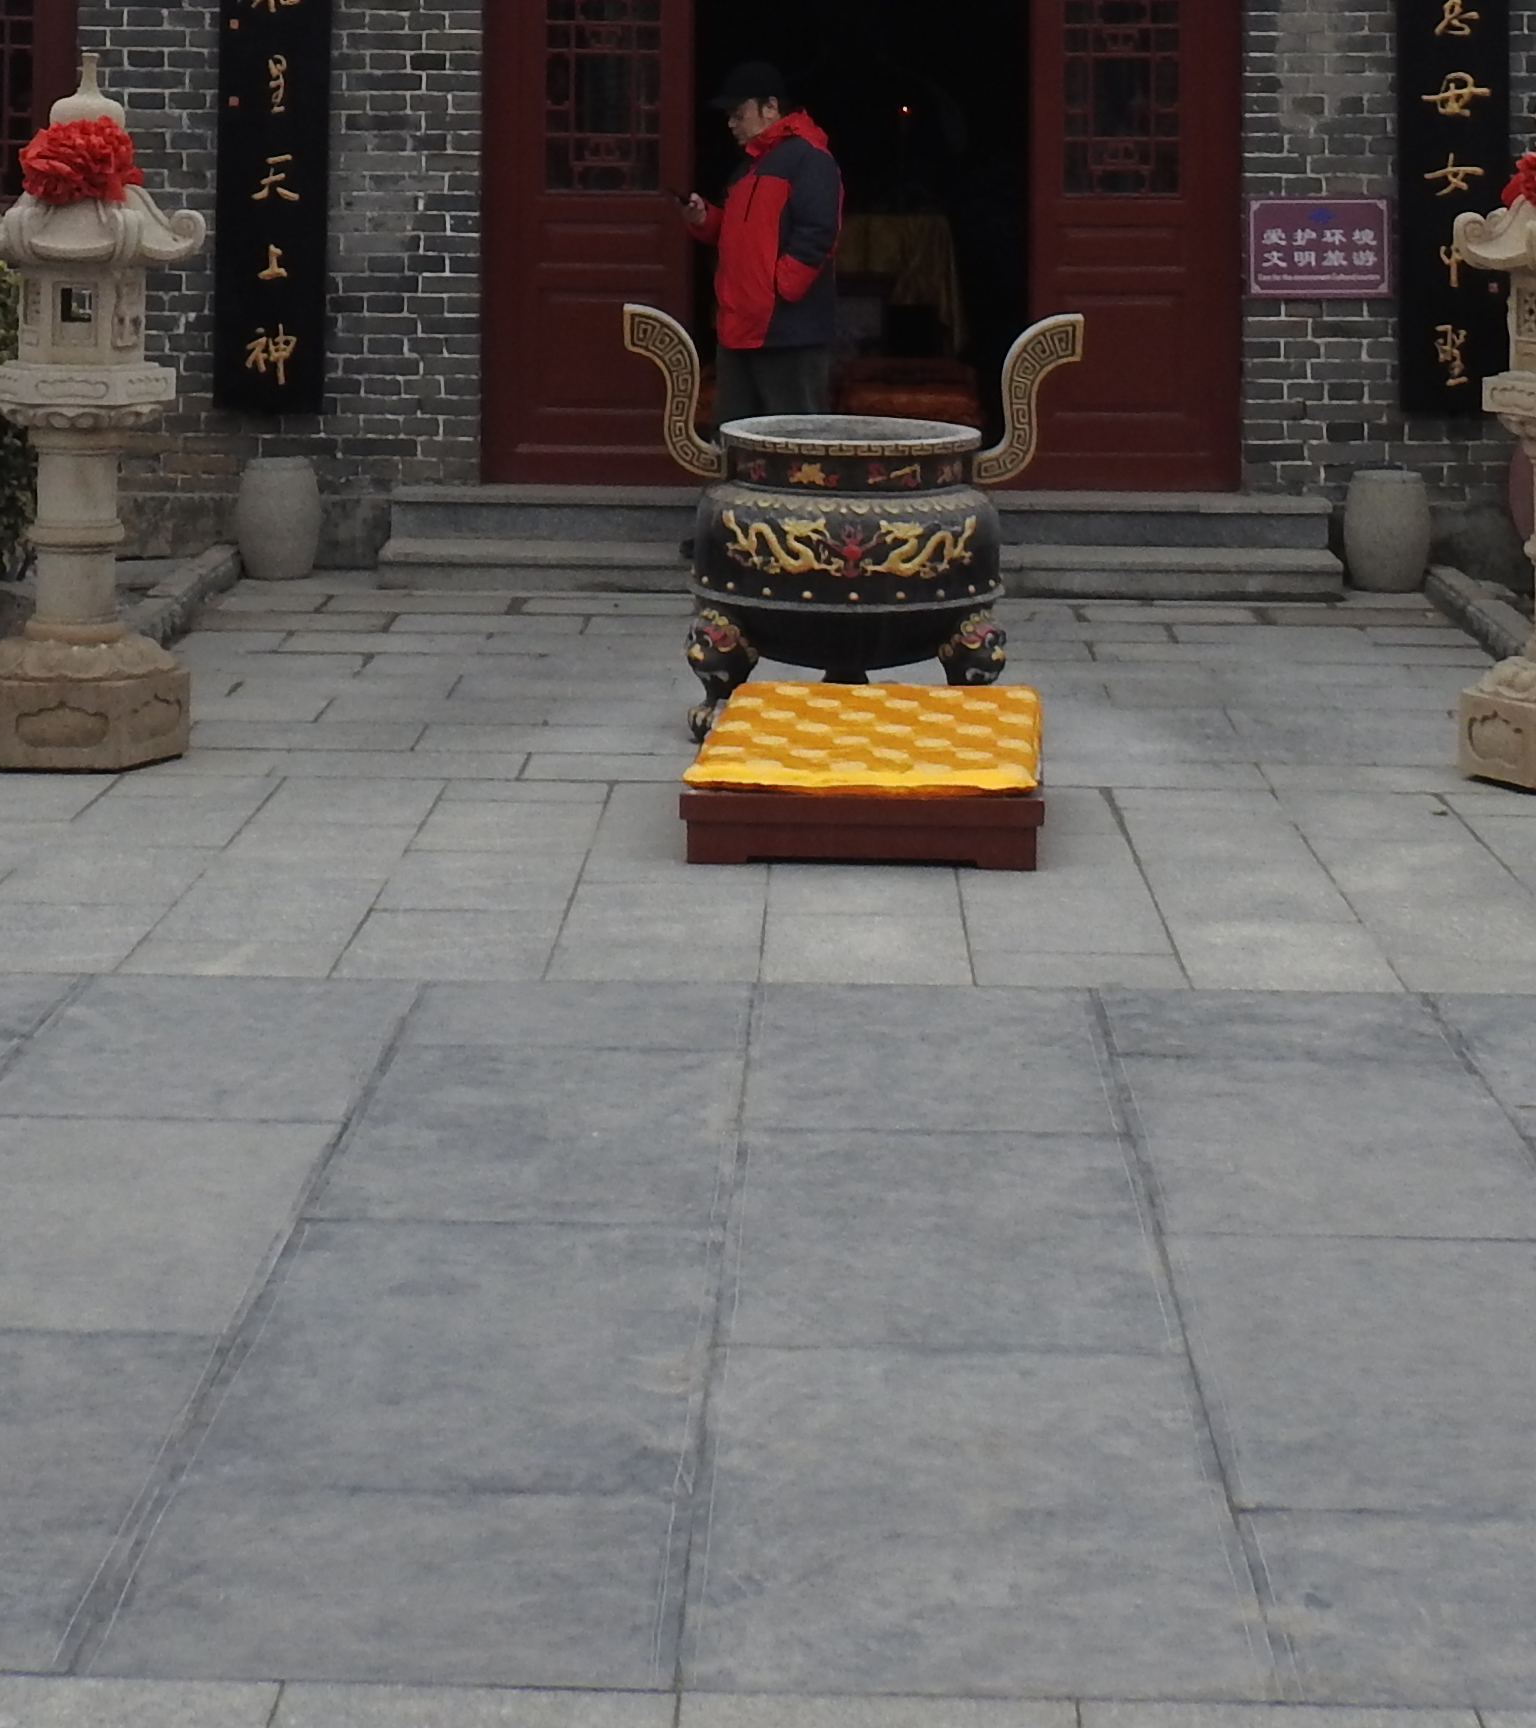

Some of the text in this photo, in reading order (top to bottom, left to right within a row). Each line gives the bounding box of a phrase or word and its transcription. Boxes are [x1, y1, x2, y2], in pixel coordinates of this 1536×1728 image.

[1262, 228, 1377, 246] 爱护环境
[1262, 250, 1378, 267] 文明旅游
